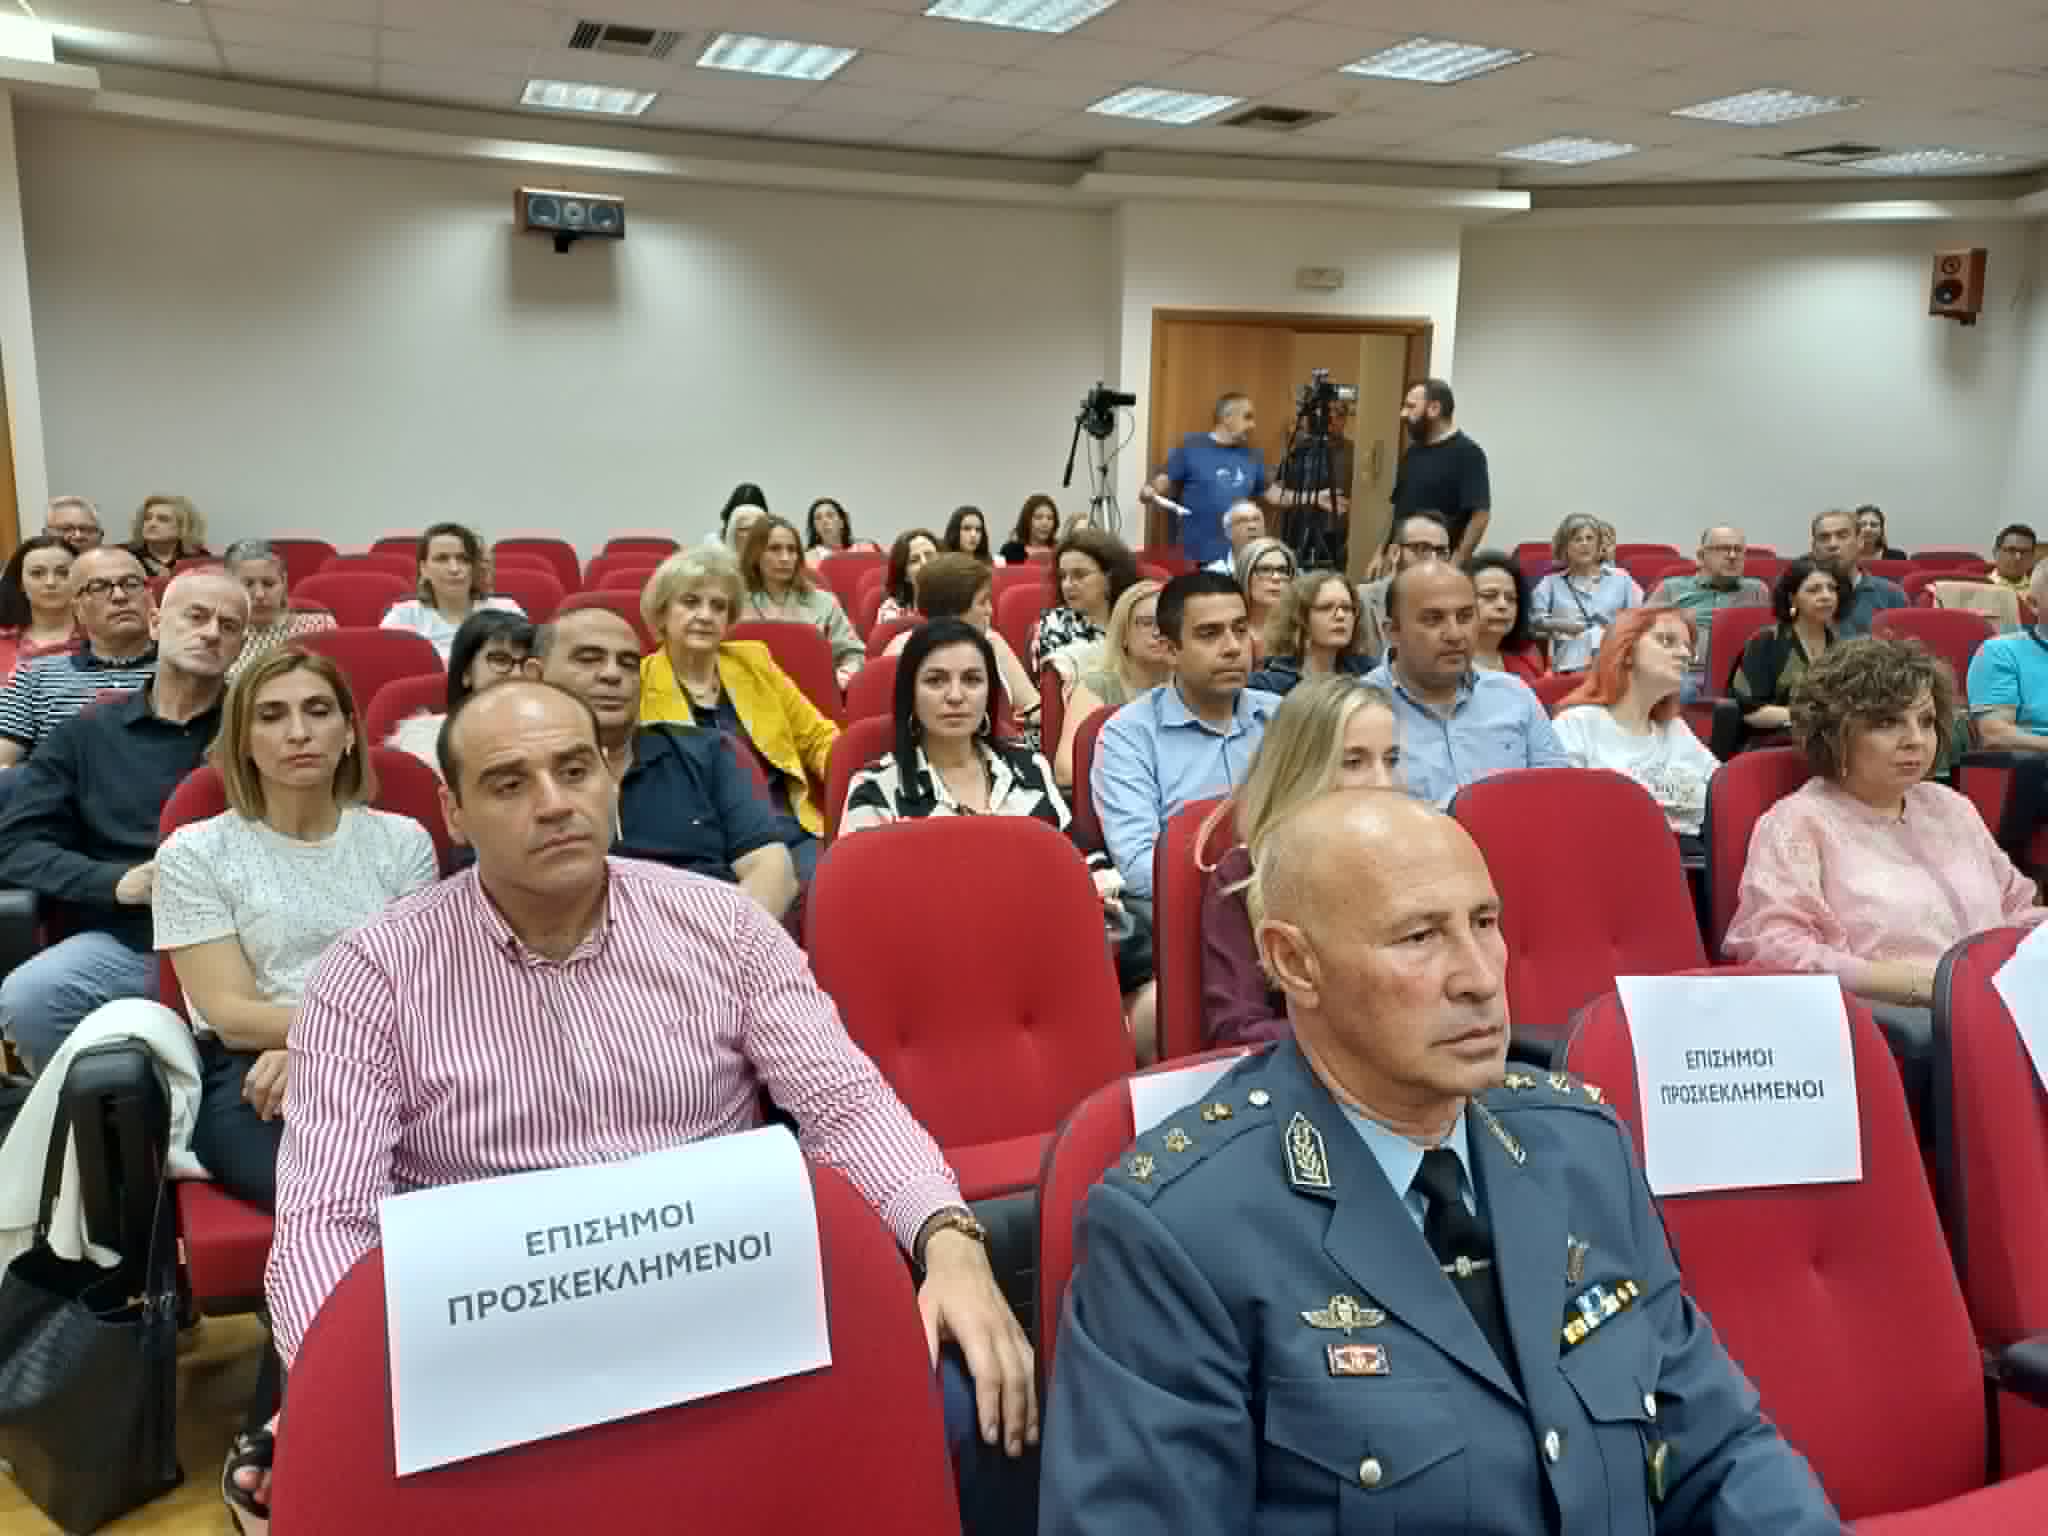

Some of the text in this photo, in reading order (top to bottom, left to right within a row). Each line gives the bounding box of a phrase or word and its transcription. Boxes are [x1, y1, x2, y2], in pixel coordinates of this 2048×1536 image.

[1685, 1047, 1774, 1070] ΕΠΙΣΗΜΟΙ
[1660, 1079, 1824, 1105] ΠΡΟΣΚΕΚΛΗΜΕΝΟΙ
[525, 1200, 695, 1257] ΕΠΙΣΗΜΟΙ
[447, 1231, 773, 1326] ΠΡΟΣΚΕΚΛΗΜΕΝΟΙ
